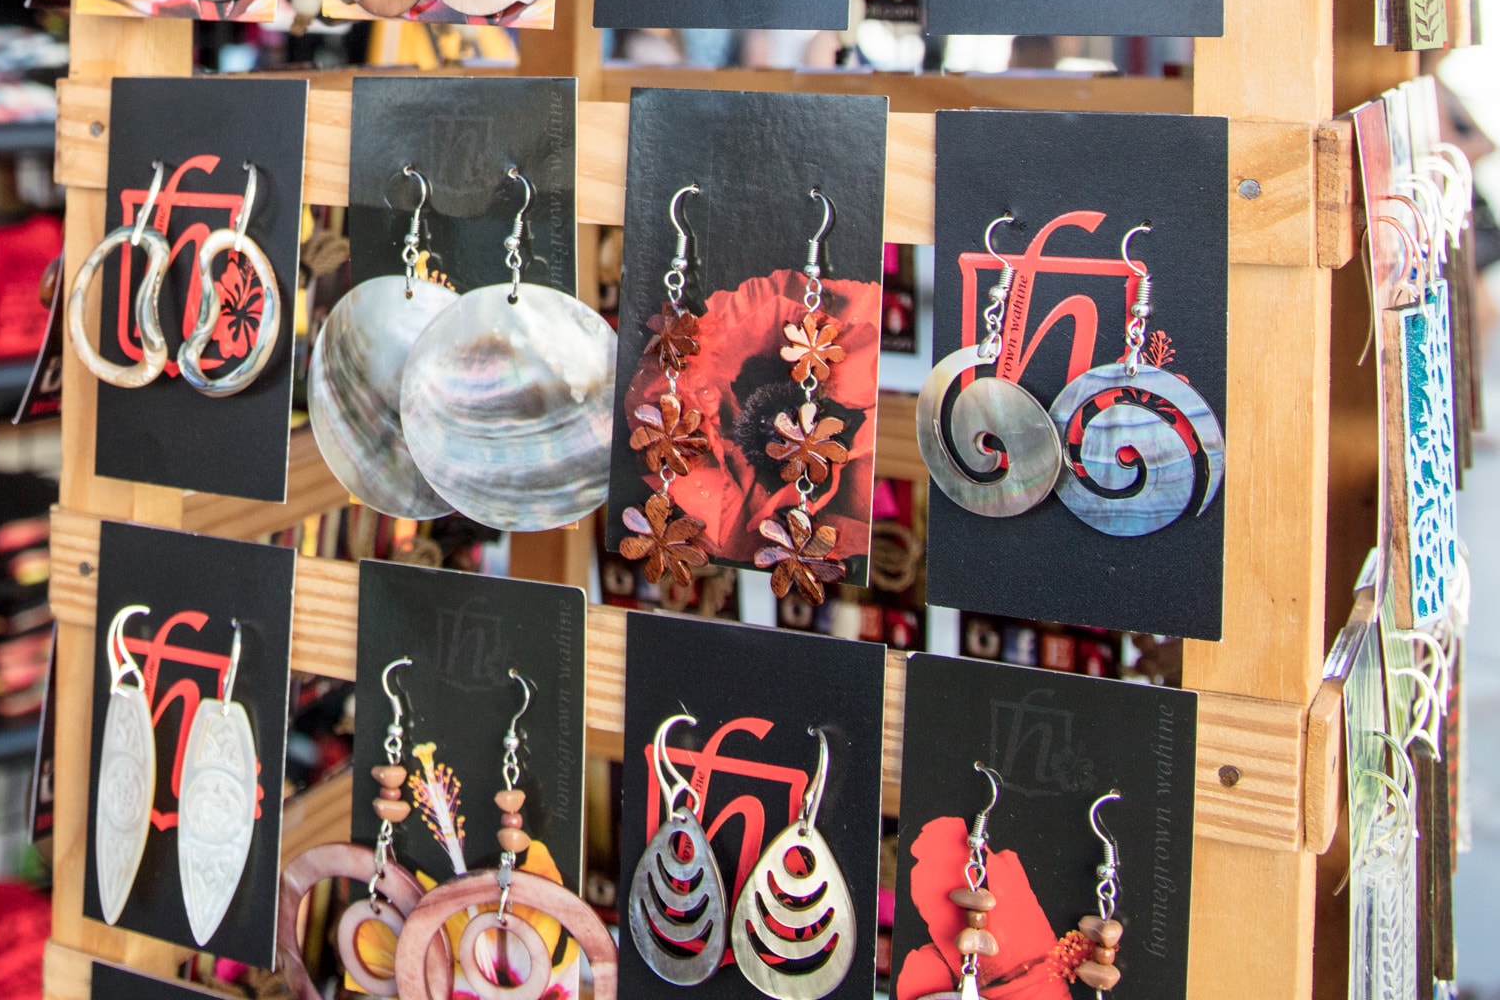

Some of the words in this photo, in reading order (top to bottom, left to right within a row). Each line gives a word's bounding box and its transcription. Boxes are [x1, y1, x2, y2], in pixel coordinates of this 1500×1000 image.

[1011, 274, 1028, 334] wahine
[558, 599, 574, 681] wahine
[552, 686, 577, 823] homegrown
[1157, 703, 1177, 796] wahine
[1145, 806, 1178, 960] homegrown
